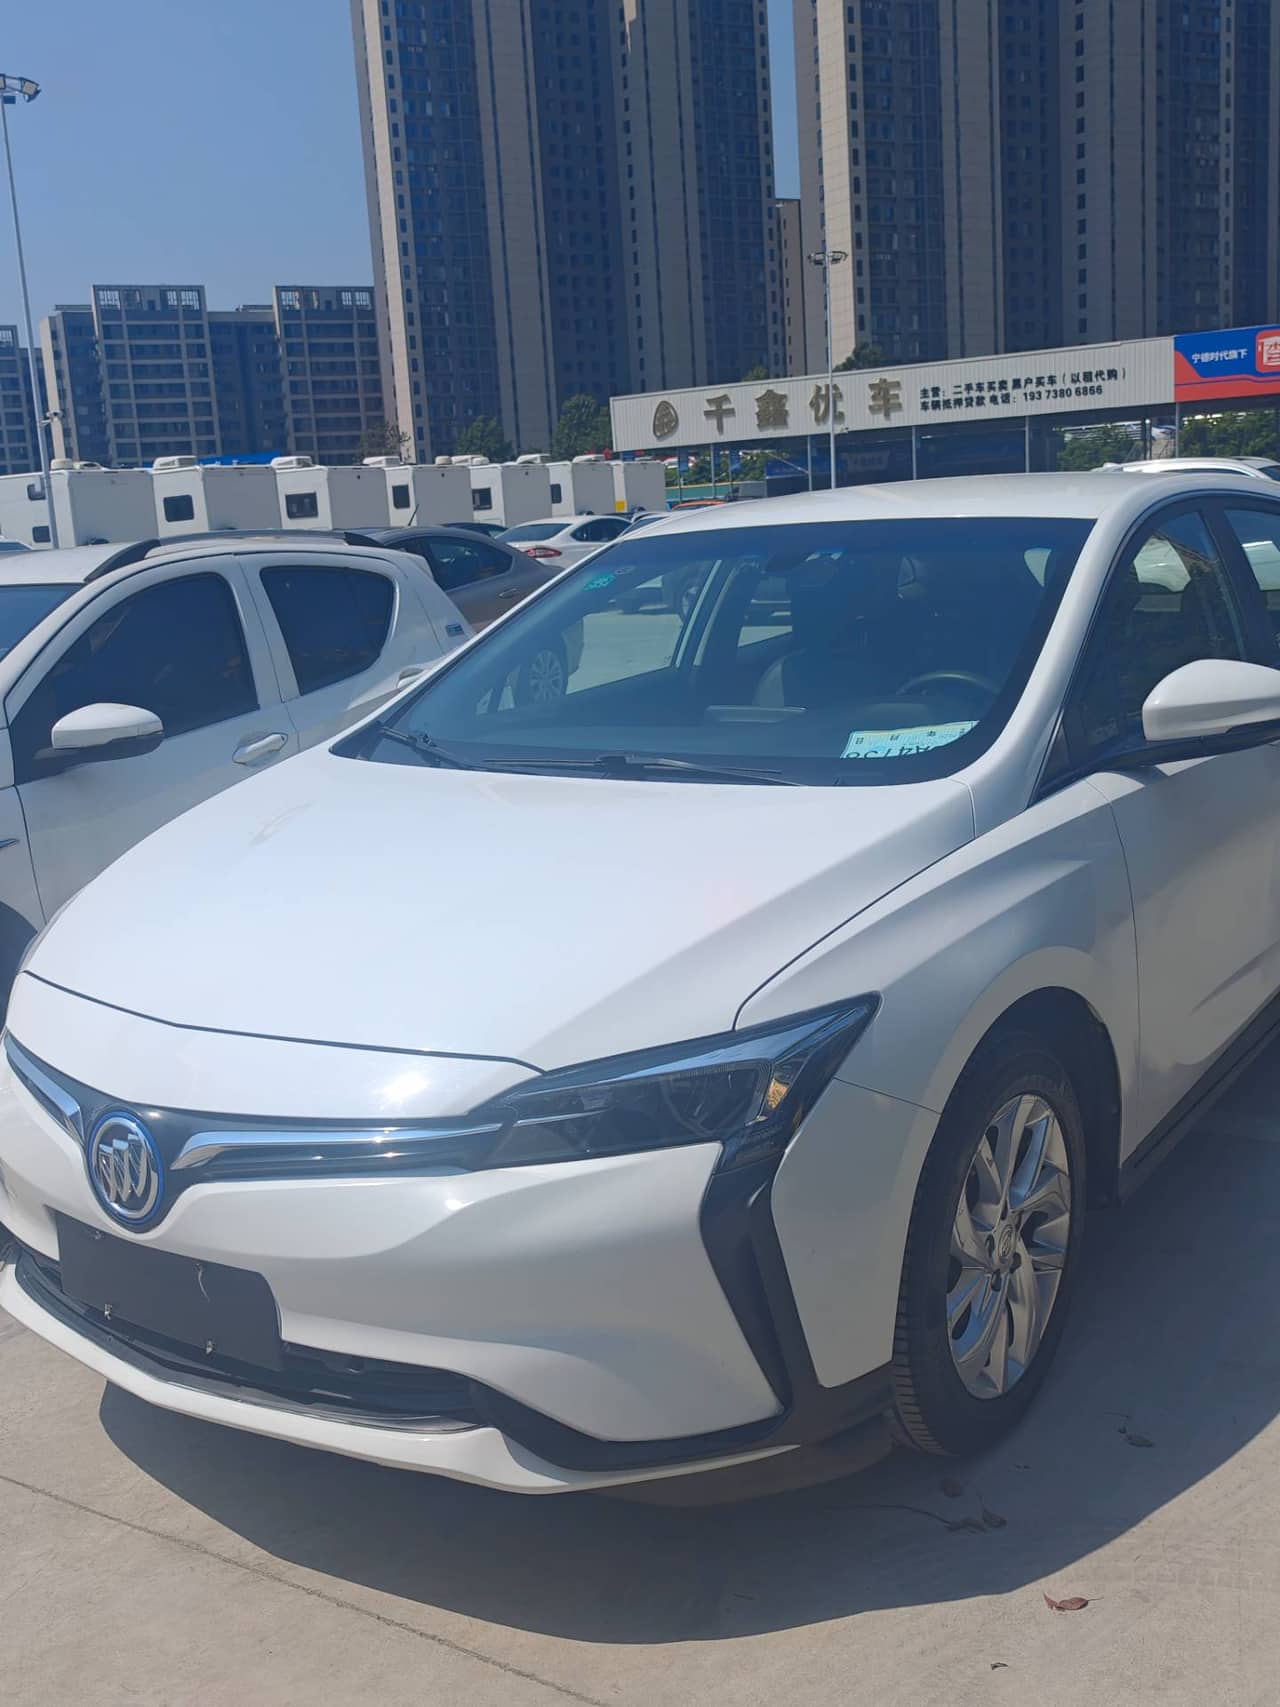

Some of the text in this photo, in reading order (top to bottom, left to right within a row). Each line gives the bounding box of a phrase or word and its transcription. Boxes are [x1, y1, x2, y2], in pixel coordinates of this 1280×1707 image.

[703, 377, 903, 435] 千鑫优车
[1045, 387, 1072, 399] 7380
